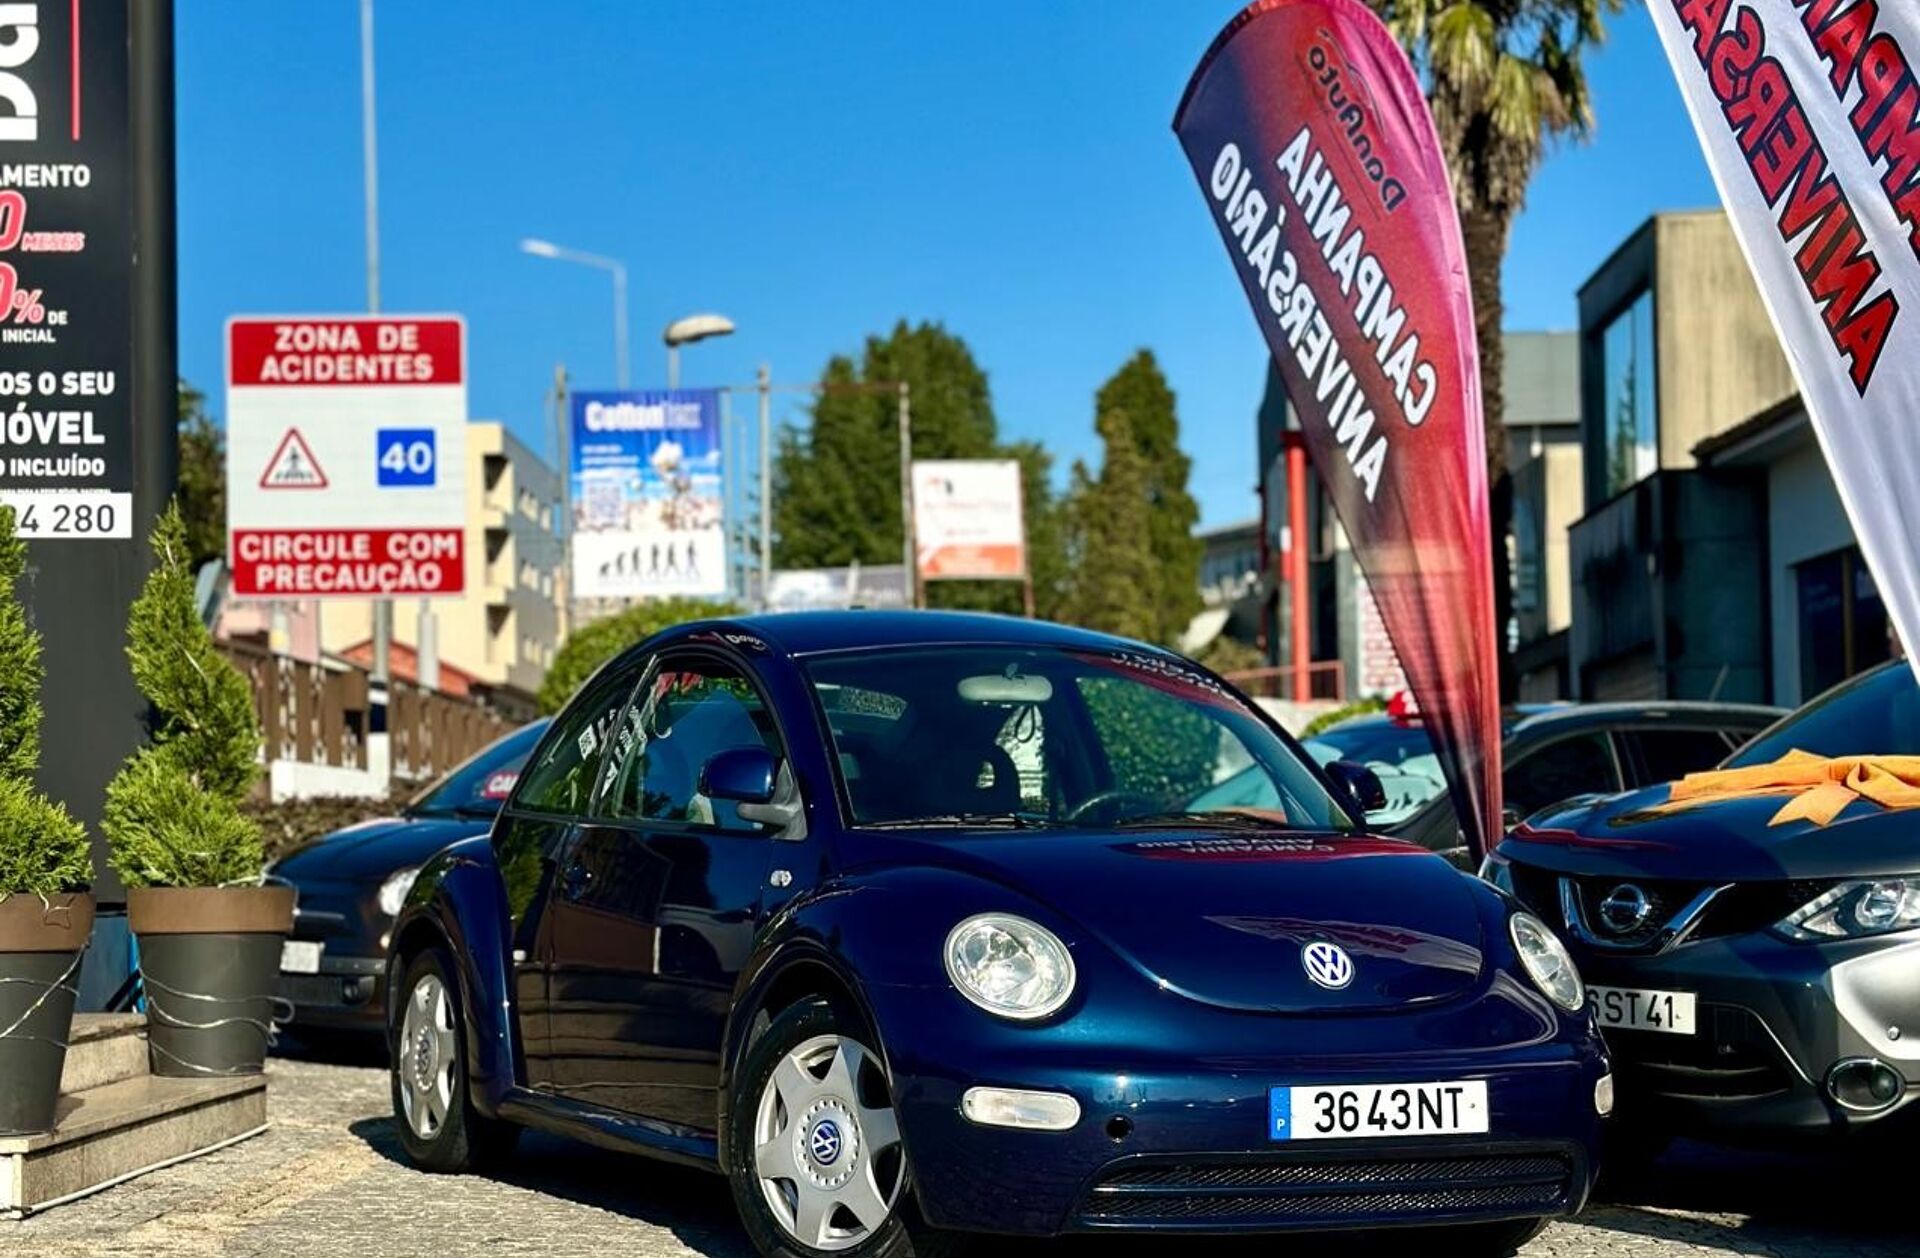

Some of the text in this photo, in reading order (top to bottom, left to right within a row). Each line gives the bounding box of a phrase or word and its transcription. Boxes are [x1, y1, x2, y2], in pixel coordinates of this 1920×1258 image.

[0, 164, 91, 187] MENTO
[48, 311, 68, 325] DE
[2, 329, 56, 343] INICIAL
[275, 325, 418, 352] ZONA DE
[259, 354, 433, 382] ACIDENTES
[38, 371, 56, 395] O
[61, 371, 115, 395] SEU
[0, 401, 105, 445] ÓVEL
[10, 453, 105, 477] INCLUÍDO
[380, 442, 432, 473] 40
[8, 504, 114, 533] 4 280
[239, 533, 457, 561] CIRCULE COM
[255, 557, 442, 592] PRECAUÇÃO
